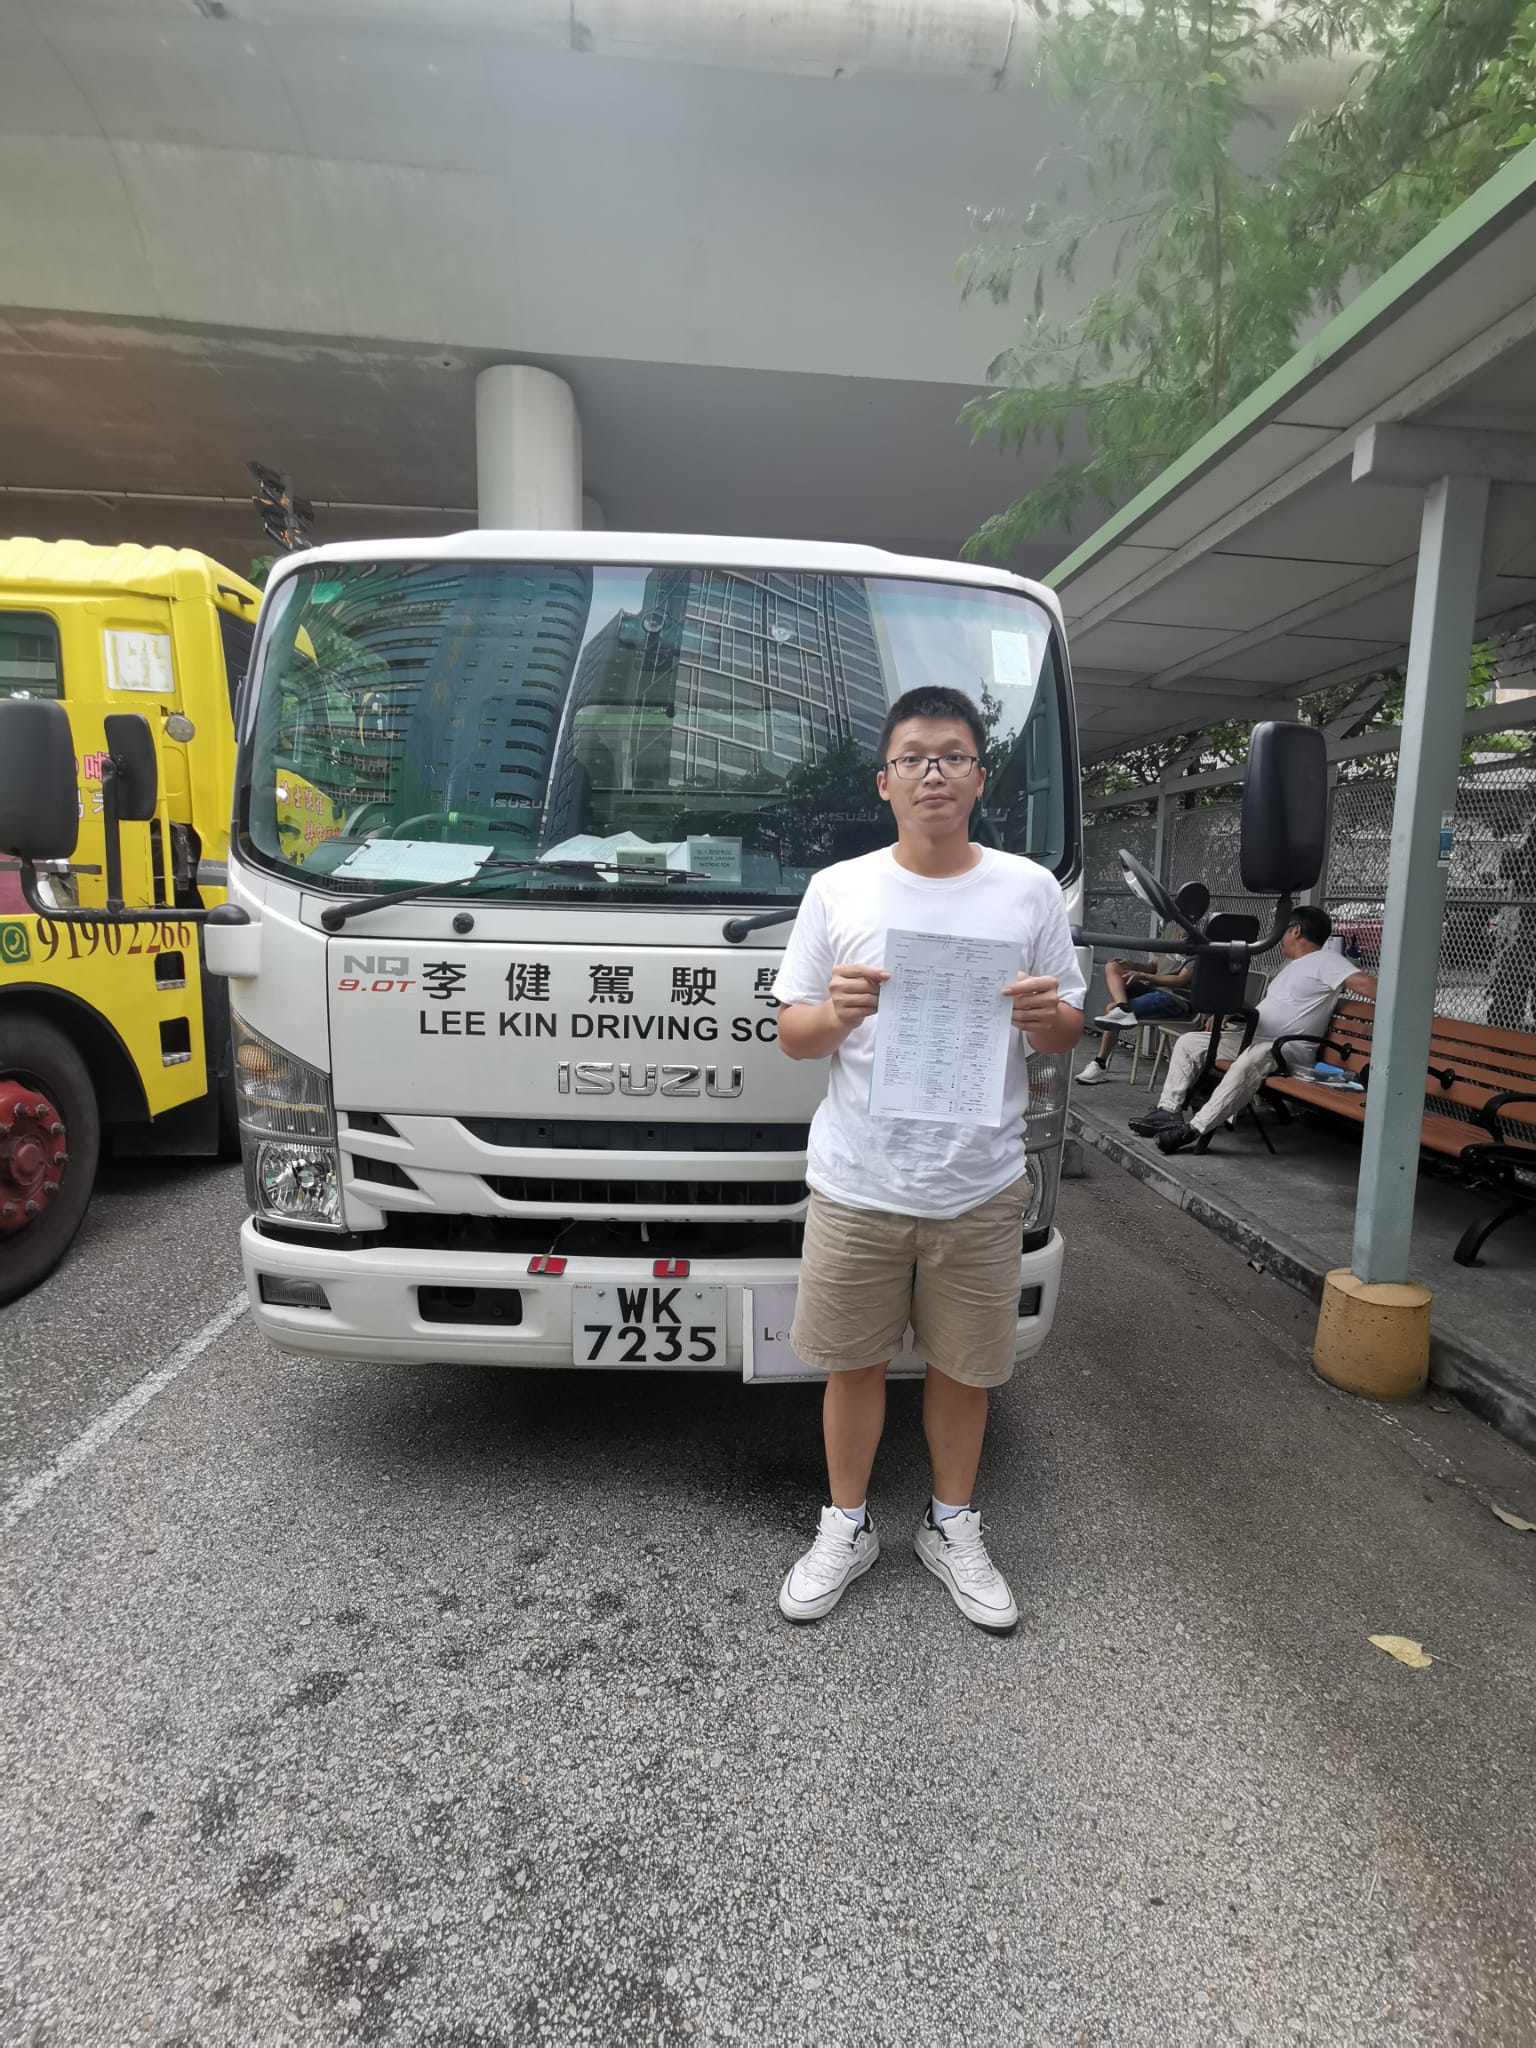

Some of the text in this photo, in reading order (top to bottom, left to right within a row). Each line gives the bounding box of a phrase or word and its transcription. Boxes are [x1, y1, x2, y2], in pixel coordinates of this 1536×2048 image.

[490, 798, 543, 809] ISUZU
[36, 917, 191, 963] 91902266
[343, 955, 410, 976] NQ
[337, 979, 417, 993] 9.0T
[420, 1010, 486, 1036] LEE
[499, 1011, 557, 1038] KIN
[571, 1013, 718, 1041] DRIVING
[558, 1061, 744, 1098] ISUZU
[616, 1287, 682, 1324] WK
[583, 1325, 717, 1363] 7235
